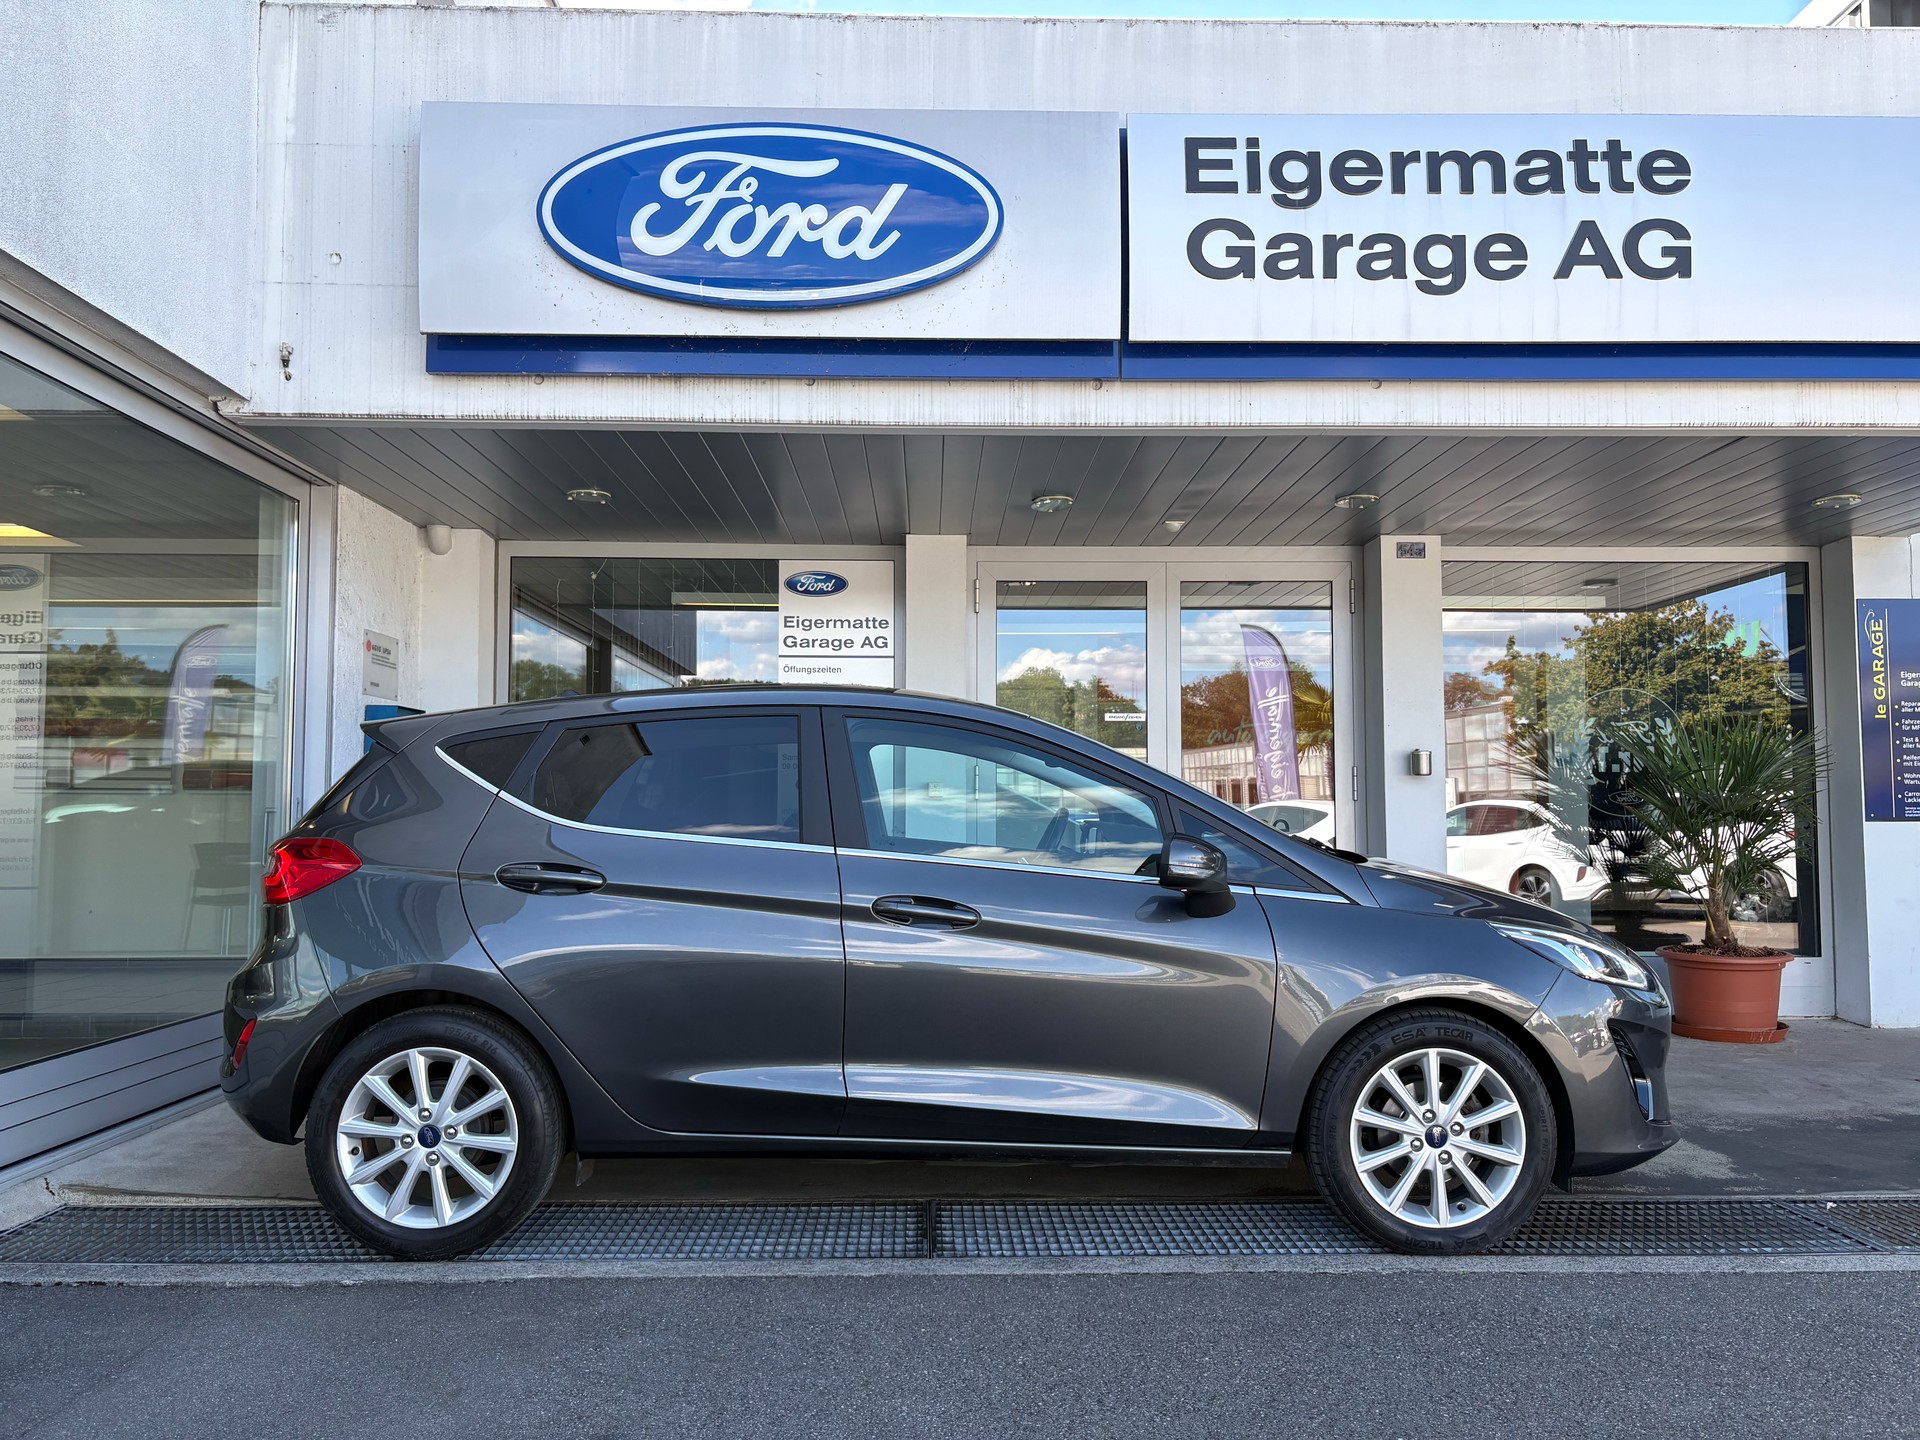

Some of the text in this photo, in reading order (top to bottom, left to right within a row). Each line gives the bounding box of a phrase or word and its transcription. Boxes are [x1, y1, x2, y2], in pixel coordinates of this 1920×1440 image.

[1184, 137, 1692, 210] Eigermatte
[630, 151, 909, 260] Ford
[1186, 218, 1692, 296] Garage AG
[796, 574, 836, 592] Ford
[783, 615, 890, 632] Eigermatte
[783, 635, 889, 652] Garage AG
[783, 664, 842, 675] Öffungszeiten
[1871, 619, 1887, 719] le GARAGE
[1435, 1026, 1474, 1042] TECAR
